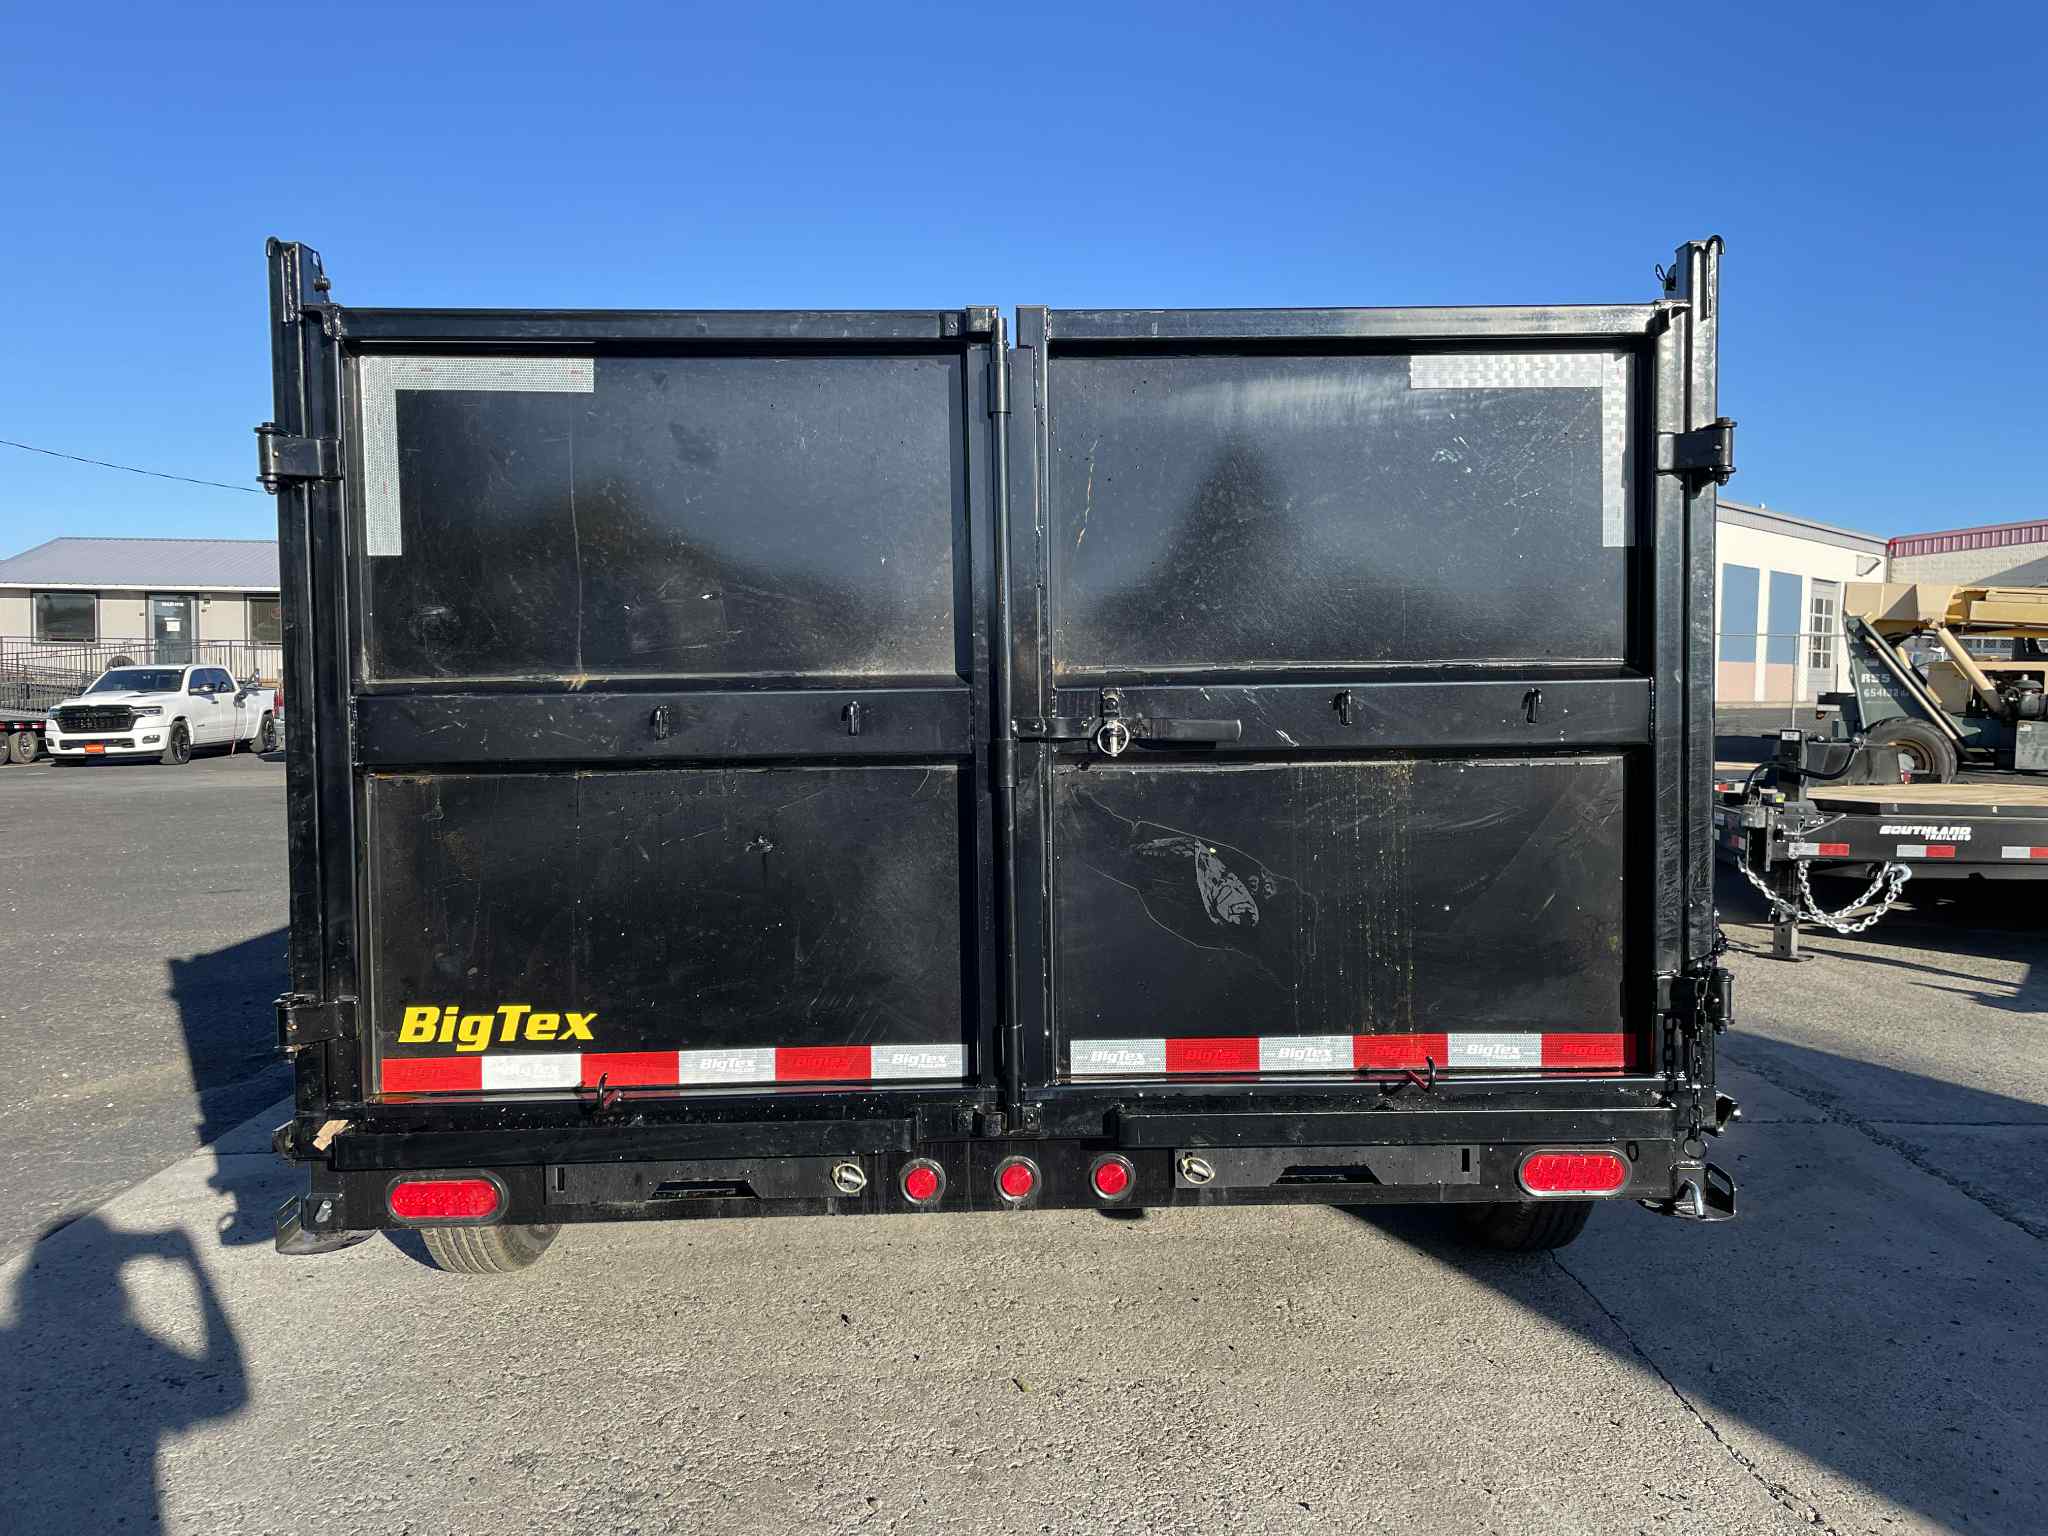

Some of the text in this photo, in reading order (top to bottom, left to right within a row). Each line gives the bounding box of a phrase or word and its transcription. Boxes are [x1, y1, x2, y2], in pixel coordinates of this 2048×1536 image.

[1880, 825, 1972, 836] SOUTHLAND
[1925, 833, 1972, 841] TRAILERS
[398, 1005, 597, 1052] BigTex
[1089, 1050, 1143, 1063] BigTex
[1279, 1046, 1332, 1060] BigTex
[1466, 1043, 1520, 1057] BigTex
[700, 1057, 755, 1071] BigTex
[891, 1053, 946, 1066] BigTex
